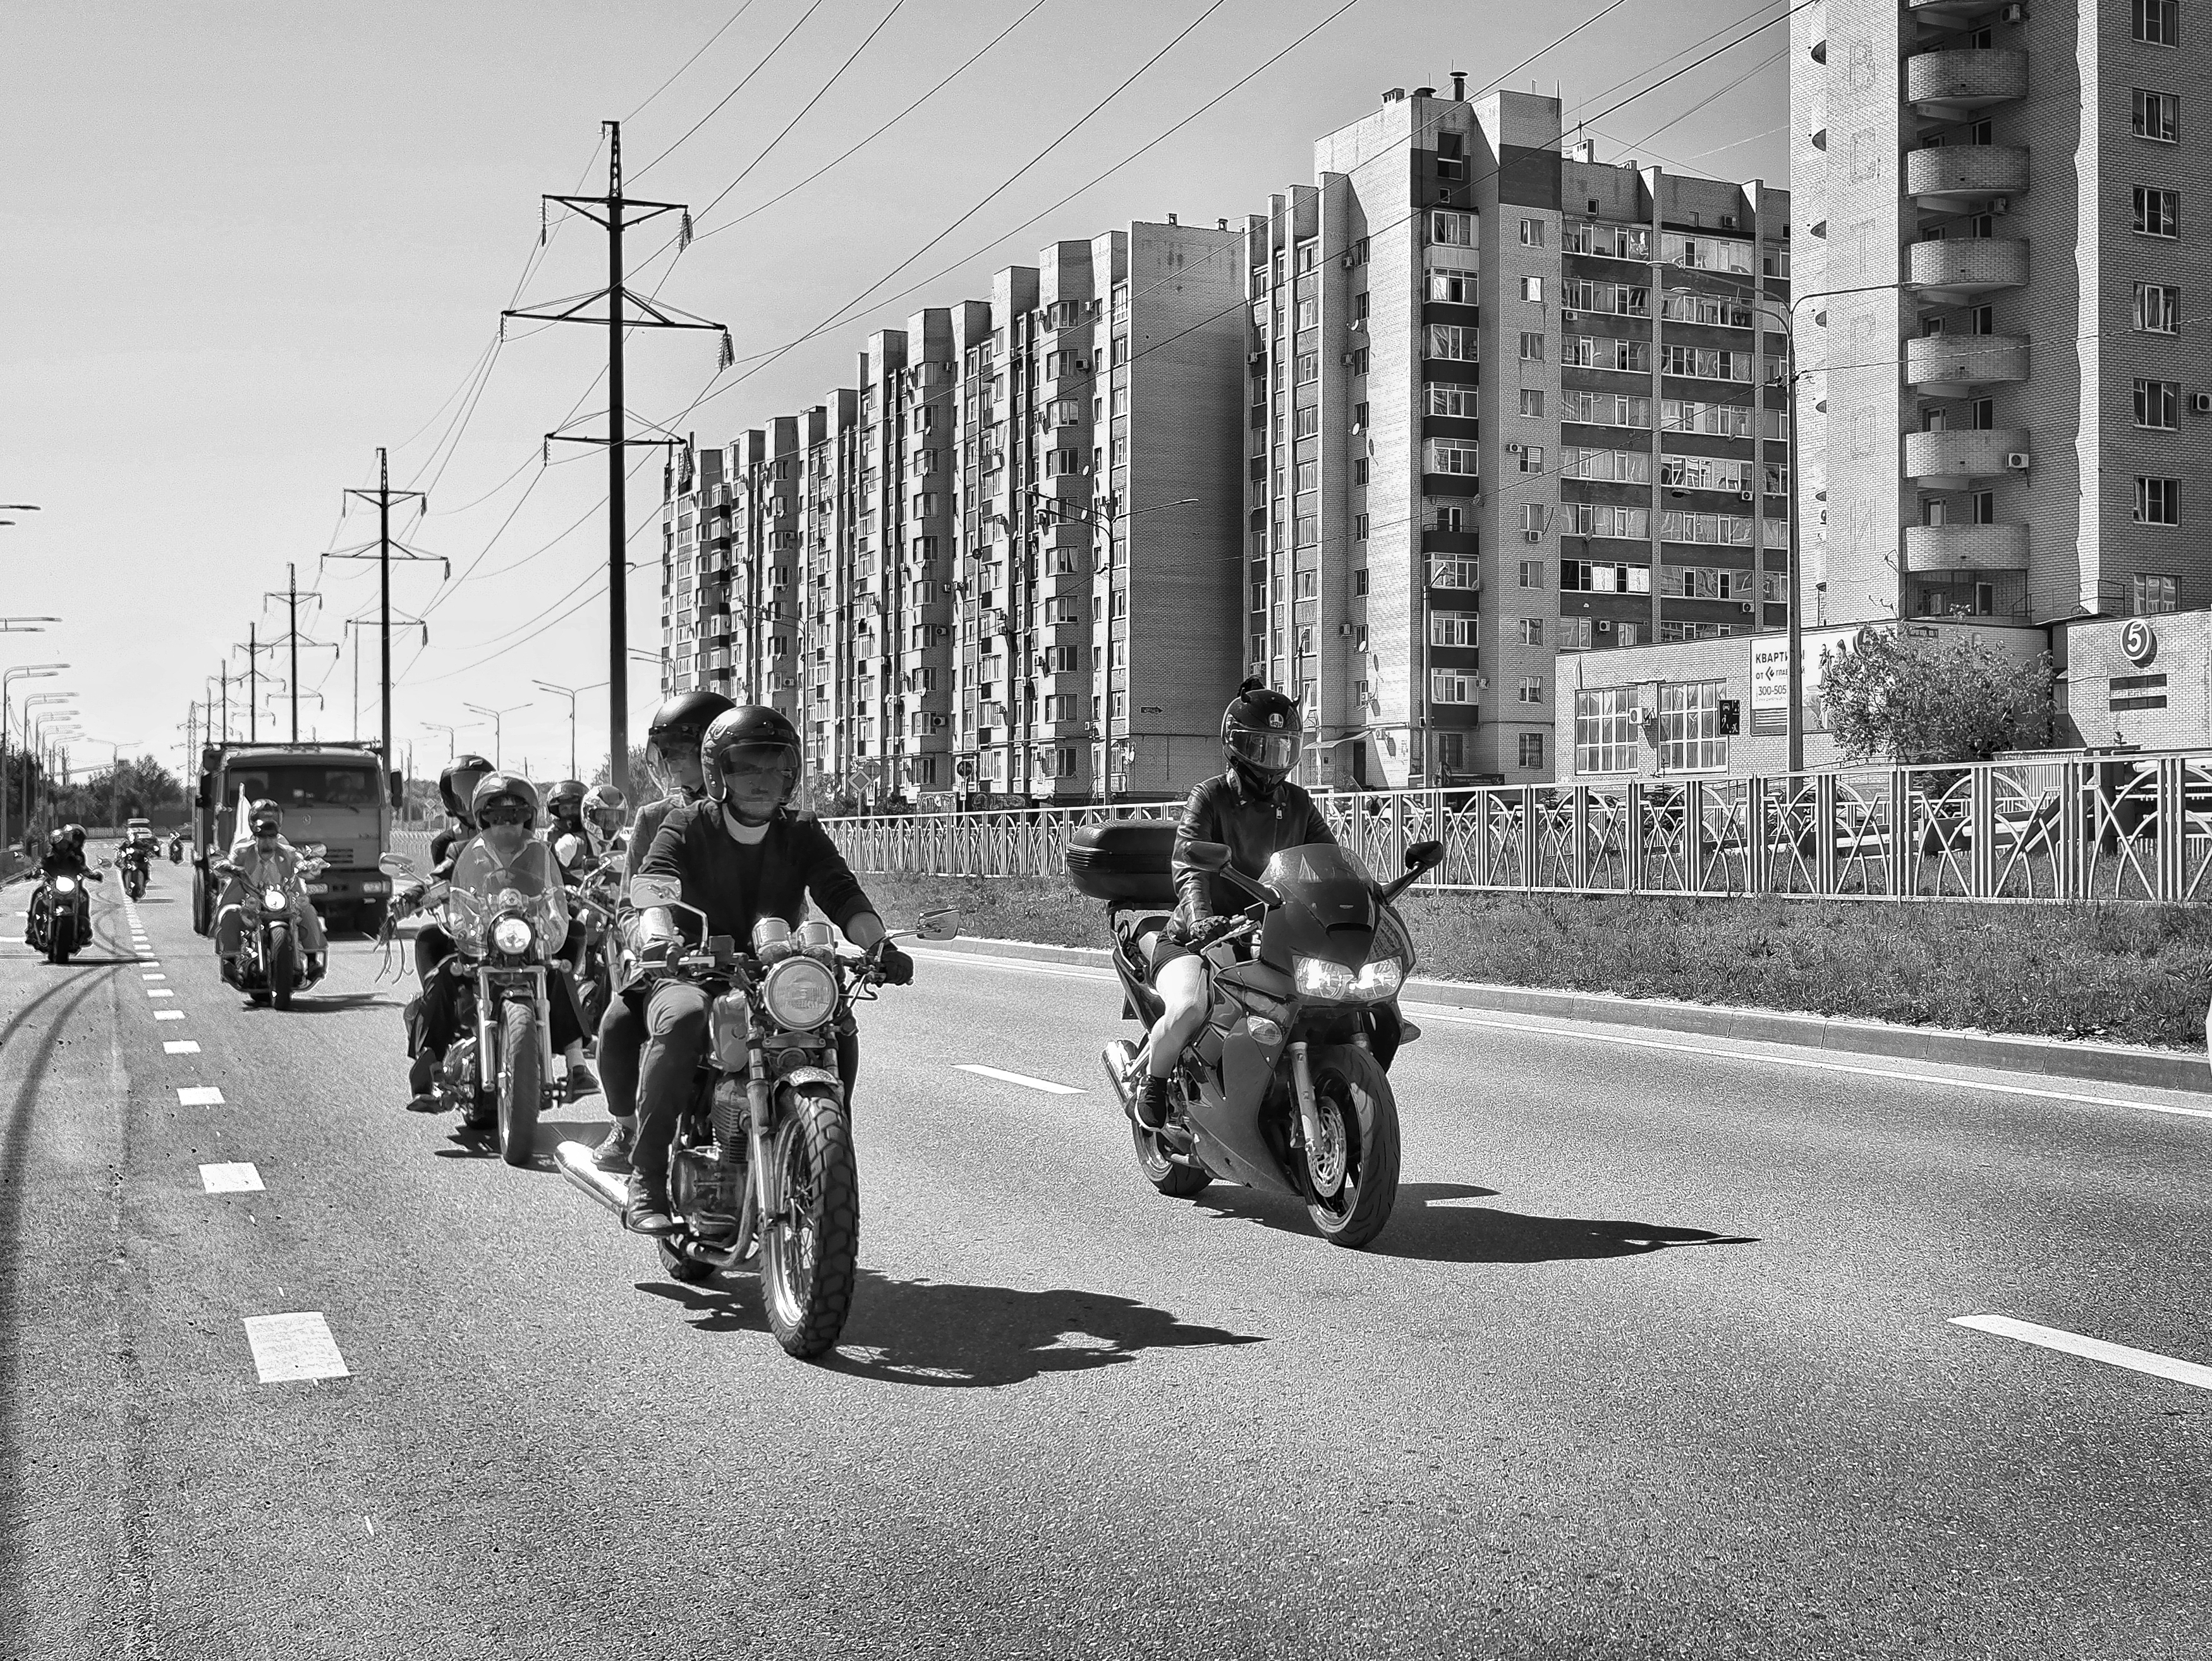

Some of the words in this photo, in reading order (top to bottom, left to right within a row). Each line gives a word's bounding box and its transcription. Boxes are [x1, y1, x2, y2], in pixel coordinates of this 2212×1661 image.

[2127, 621, 2144, 652] 5
[1756, 649, 1805, 664] КВАРТ
[1758, 684, 1787, 696] 300-505
